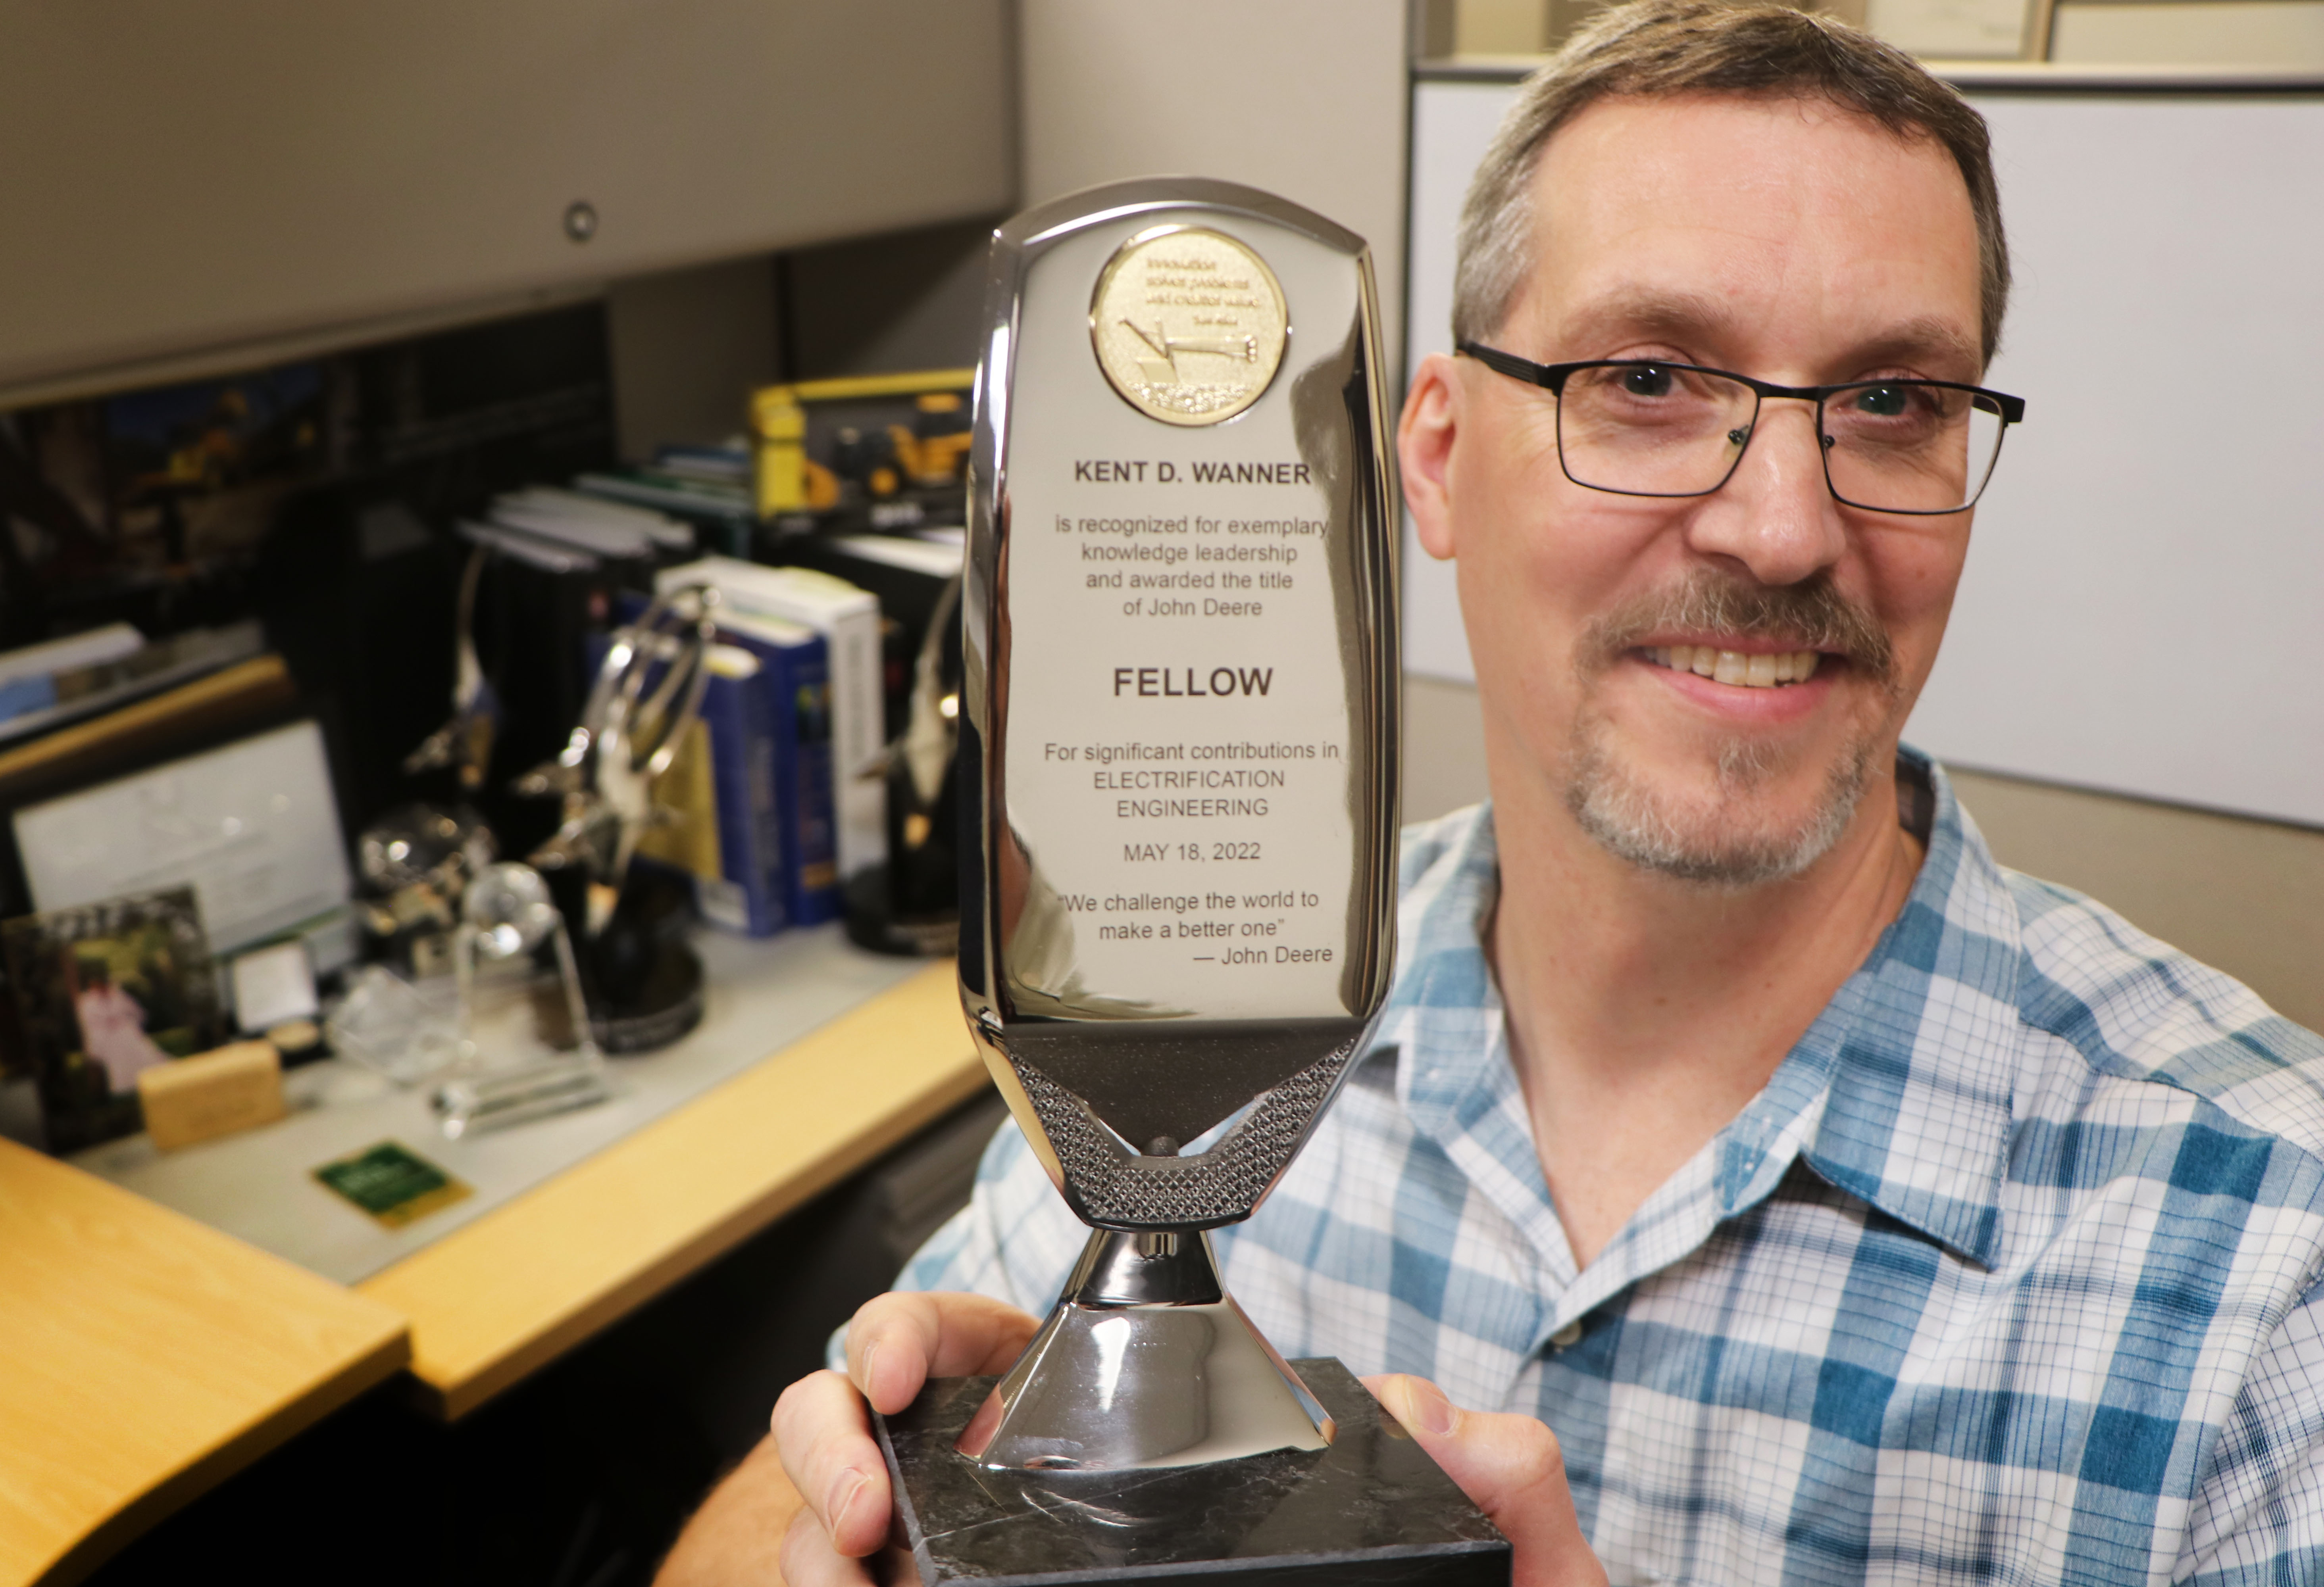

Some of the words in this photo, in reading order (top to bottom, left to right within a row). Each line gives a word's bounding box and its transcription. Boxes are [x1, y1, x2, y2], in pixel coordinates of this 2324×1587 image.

[1075, 460, 1149, 483] KENT
[1158, 461, 1183, 483] D.
[1191, 461, 1310, 485] WANNER
[1056, 515, 1072, 532] is
[1078, 516, 1188, 537] recognized
[1195, 516, 1221, 533] for
[1227, 517, 1328, 539] exemplary
[1082, 543, 1188, 565] knowledge
[1196, 544, 1297, 565] leadership
[1086, 571, 1122, 588] and
[1129, 572, 1214, 588] awarded
[1222, 572, 1252, 588] the
[1259, 572, 1293, 589] title
[1124, 598, 1142, 616] of
[1148, 599, 1195, 616] John
[1204, 598, 1262, 616] Deere
[1114, 667, 1274, 697] FELLOW
[1045, 743, 1078, 761] For
[1084, 742, 1184, 765] significant
[1191, 742, 1316, 759] contributions
[1323, 741, 1338, 758] in
[1094, 770, 1284, 790] ELECTRIFICATION
[1117, 798, 1268, 818] ENGINEERING
[1124, 844, 1169, 861] MAY
[1178, 843, 1205, 863] 18,
[1213, 842, 1260, 861] 2022
[1104, 893, 1199, 914] challenge
[1206, 891, 1236, 909] the
[1242, 891, 1294, 908] world
[1301, 891, 1319, 907] to
[1100, 922, 1153, 940] make
[1160, 924, 1171, 938] a
[1178, 921, 1235, 938] better
[1222, 947, 1268, 965] John
[1275, 946, 1333, 963] Deere
